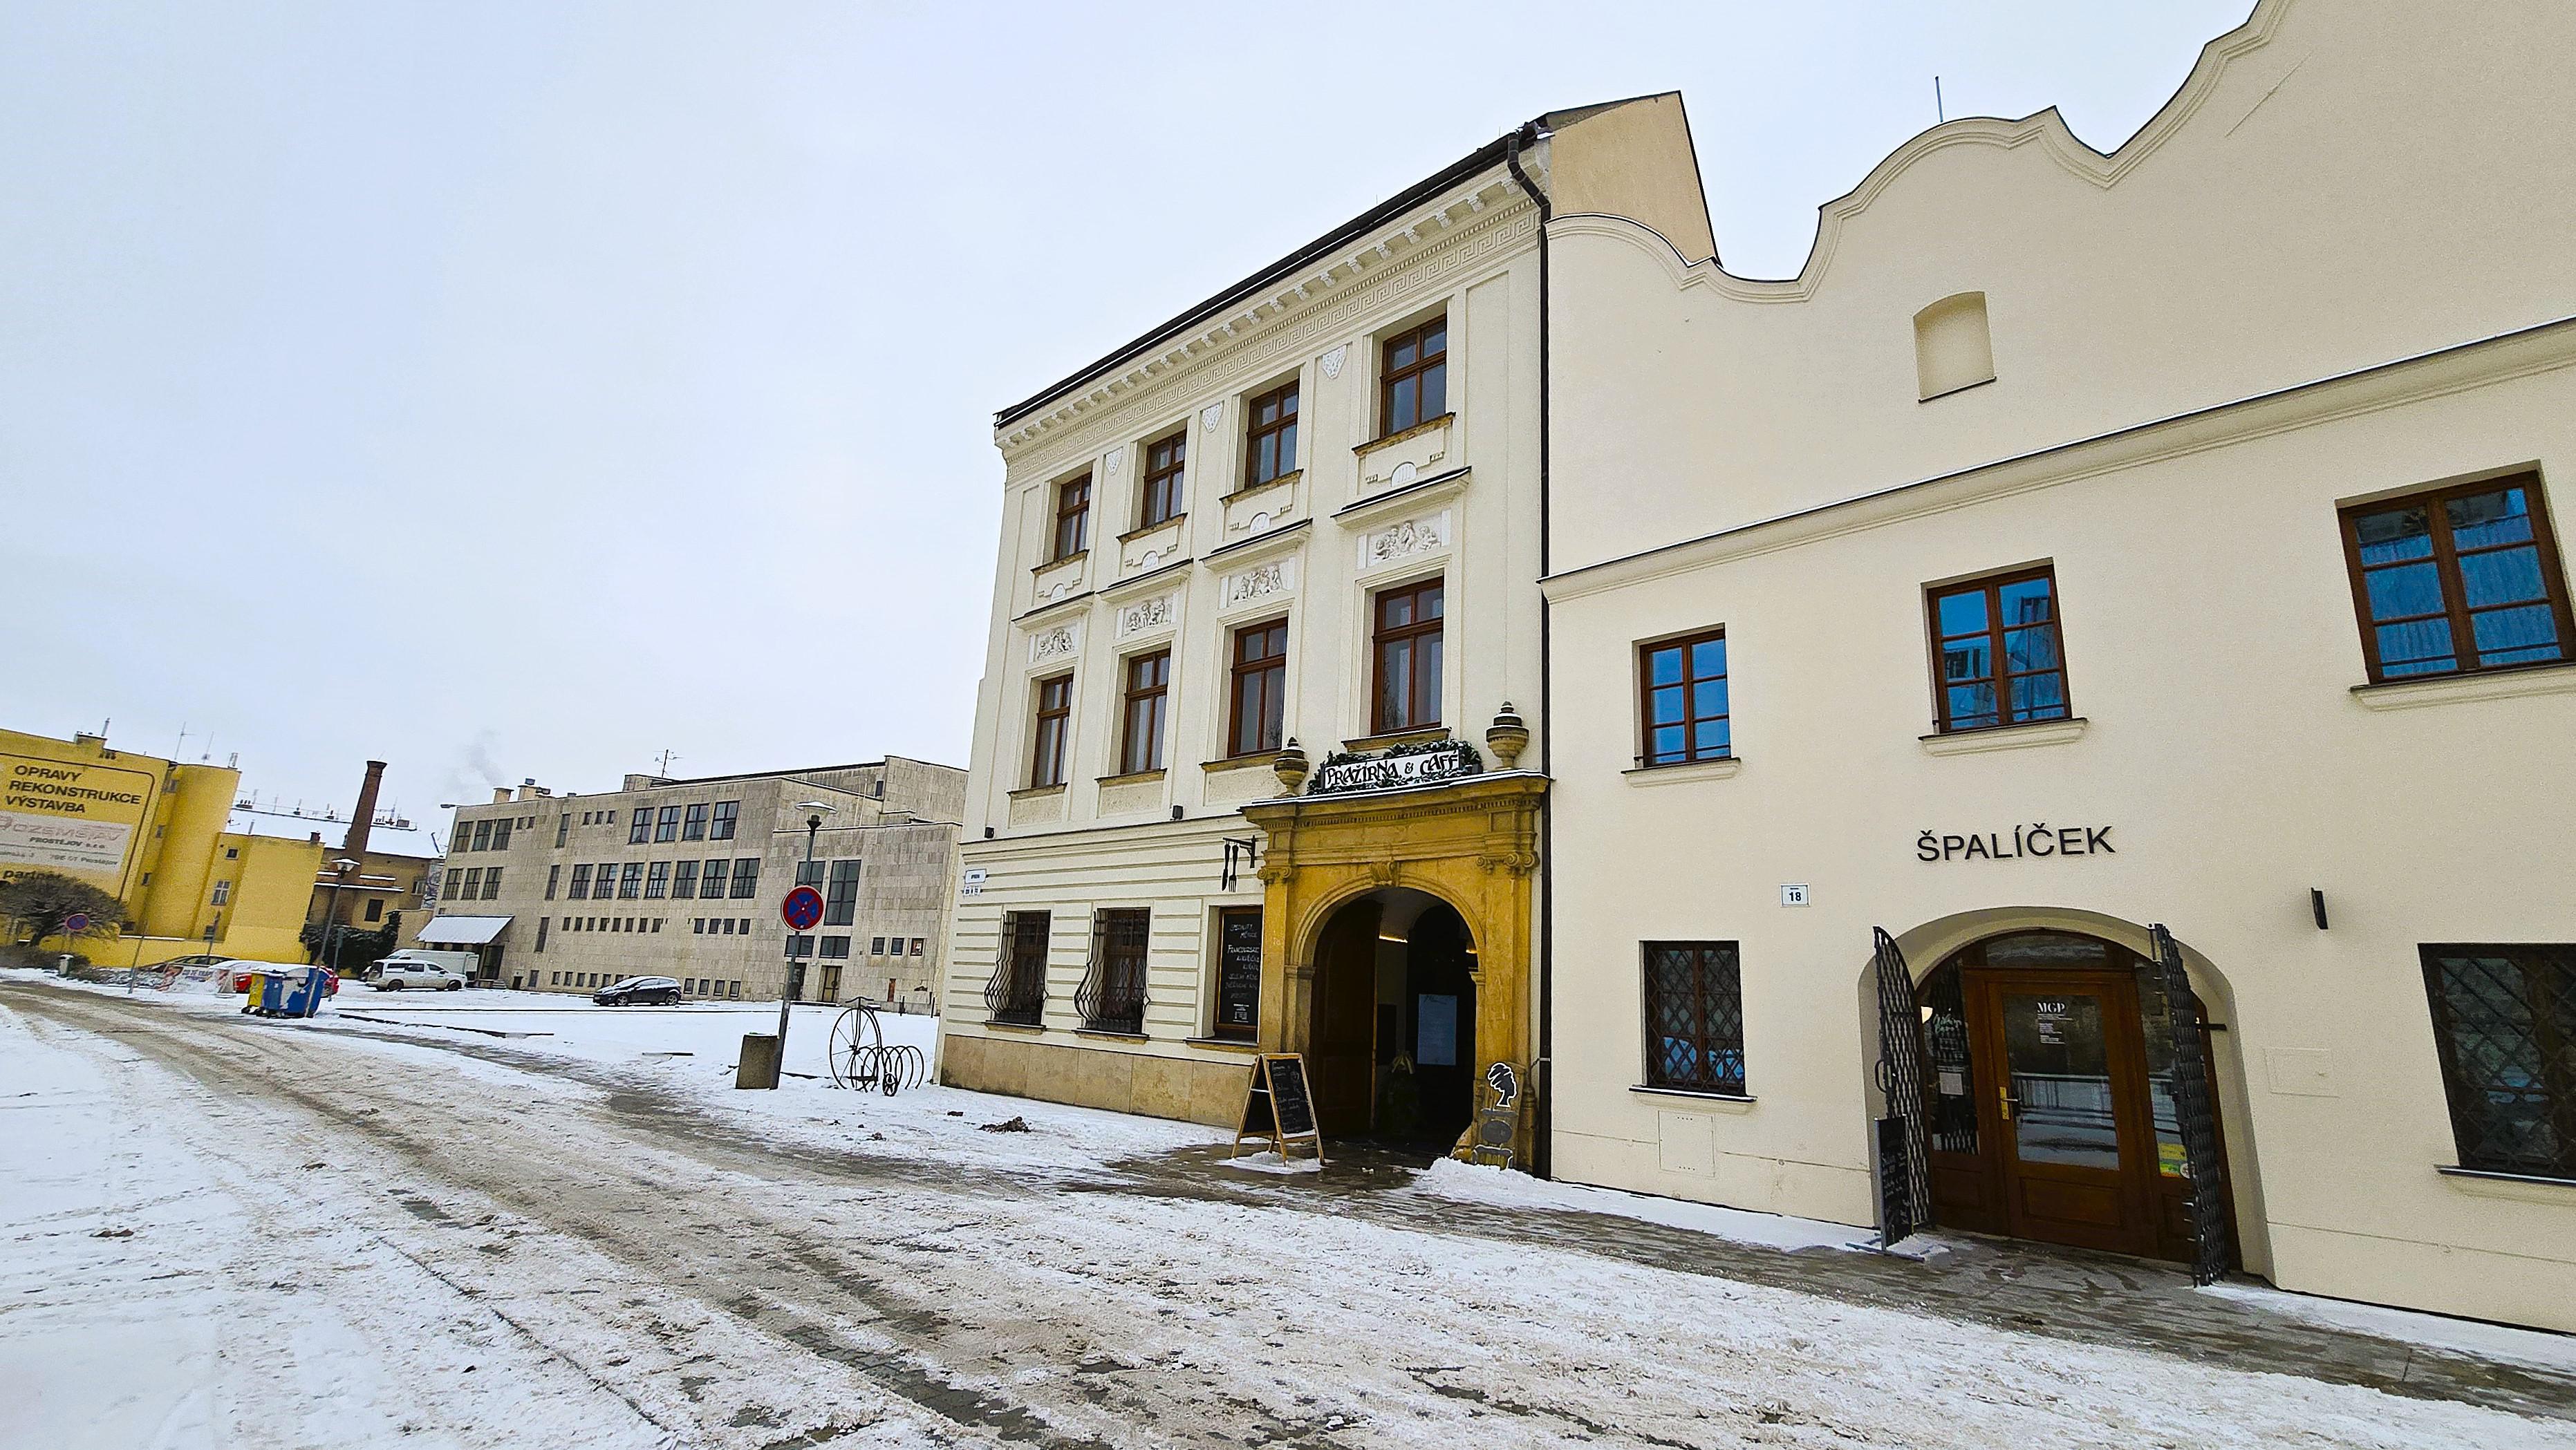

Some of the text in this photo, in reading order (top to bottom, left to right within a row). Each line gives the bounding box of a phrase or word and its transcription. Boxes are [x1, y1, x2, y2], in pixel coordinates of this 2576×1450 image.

[14, 765, 82, 782] OPRAVY
[1404, 762, 1414, 774] &
[9, 780, 142, 804] REKONSTRUKCE
[6, 795, 85, 813] VÝSTAVBA
[1916, 822, 2116, 862] ŠPALÍČEK
[1789, 892, 1802, 902] 18
[2037, 1002, 2065, 1013] MGP
